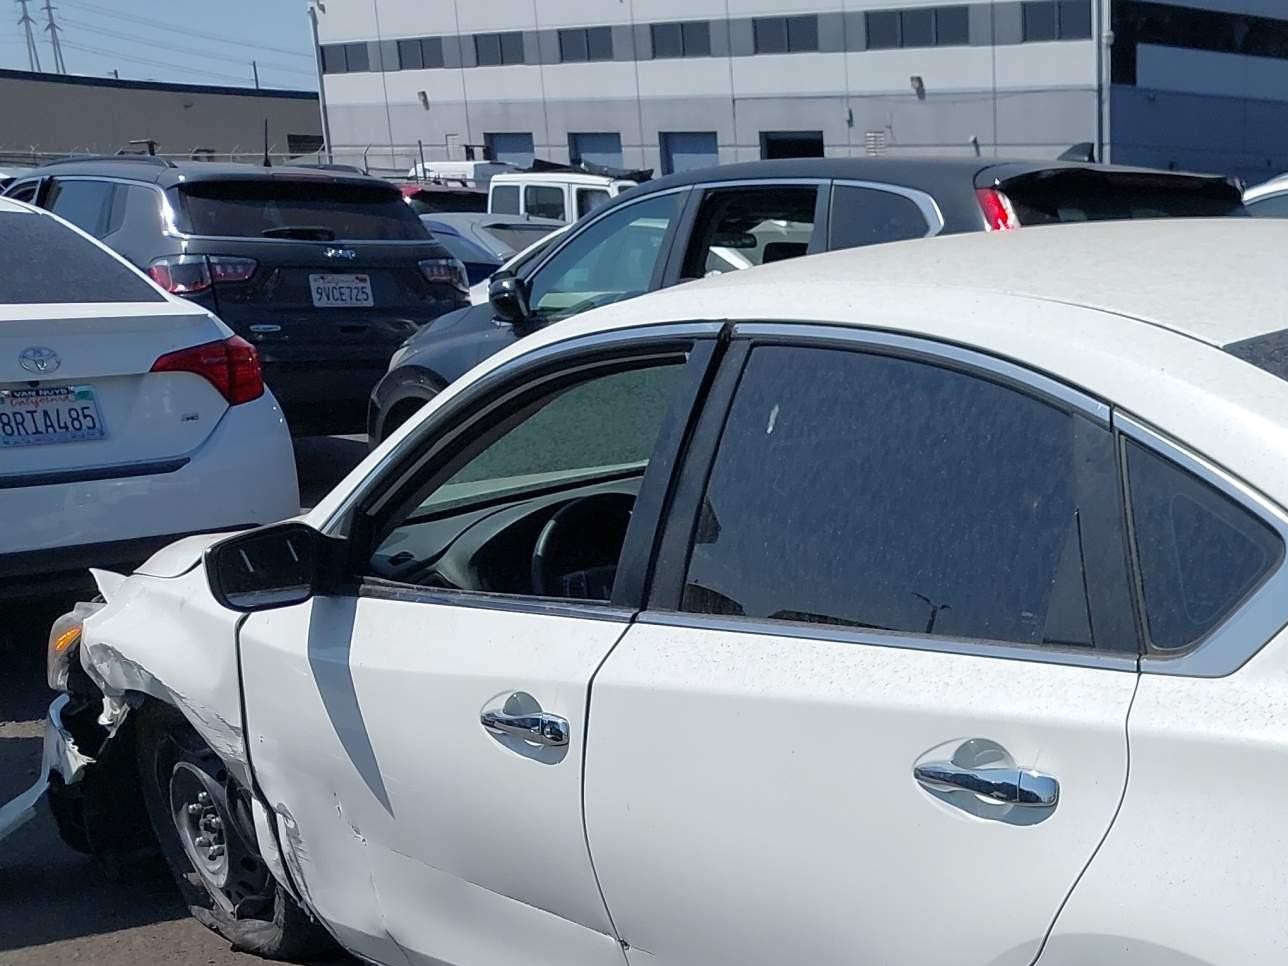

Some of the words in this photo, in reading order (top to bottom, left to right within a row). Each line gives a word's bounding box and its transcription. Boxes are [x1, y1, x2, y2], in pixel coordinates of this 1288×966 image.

[323, 247, 356, 260] Jeep
[315, 285, 370, 302] 9VCE725
[0, 406, 97, 437] 8RIA485
